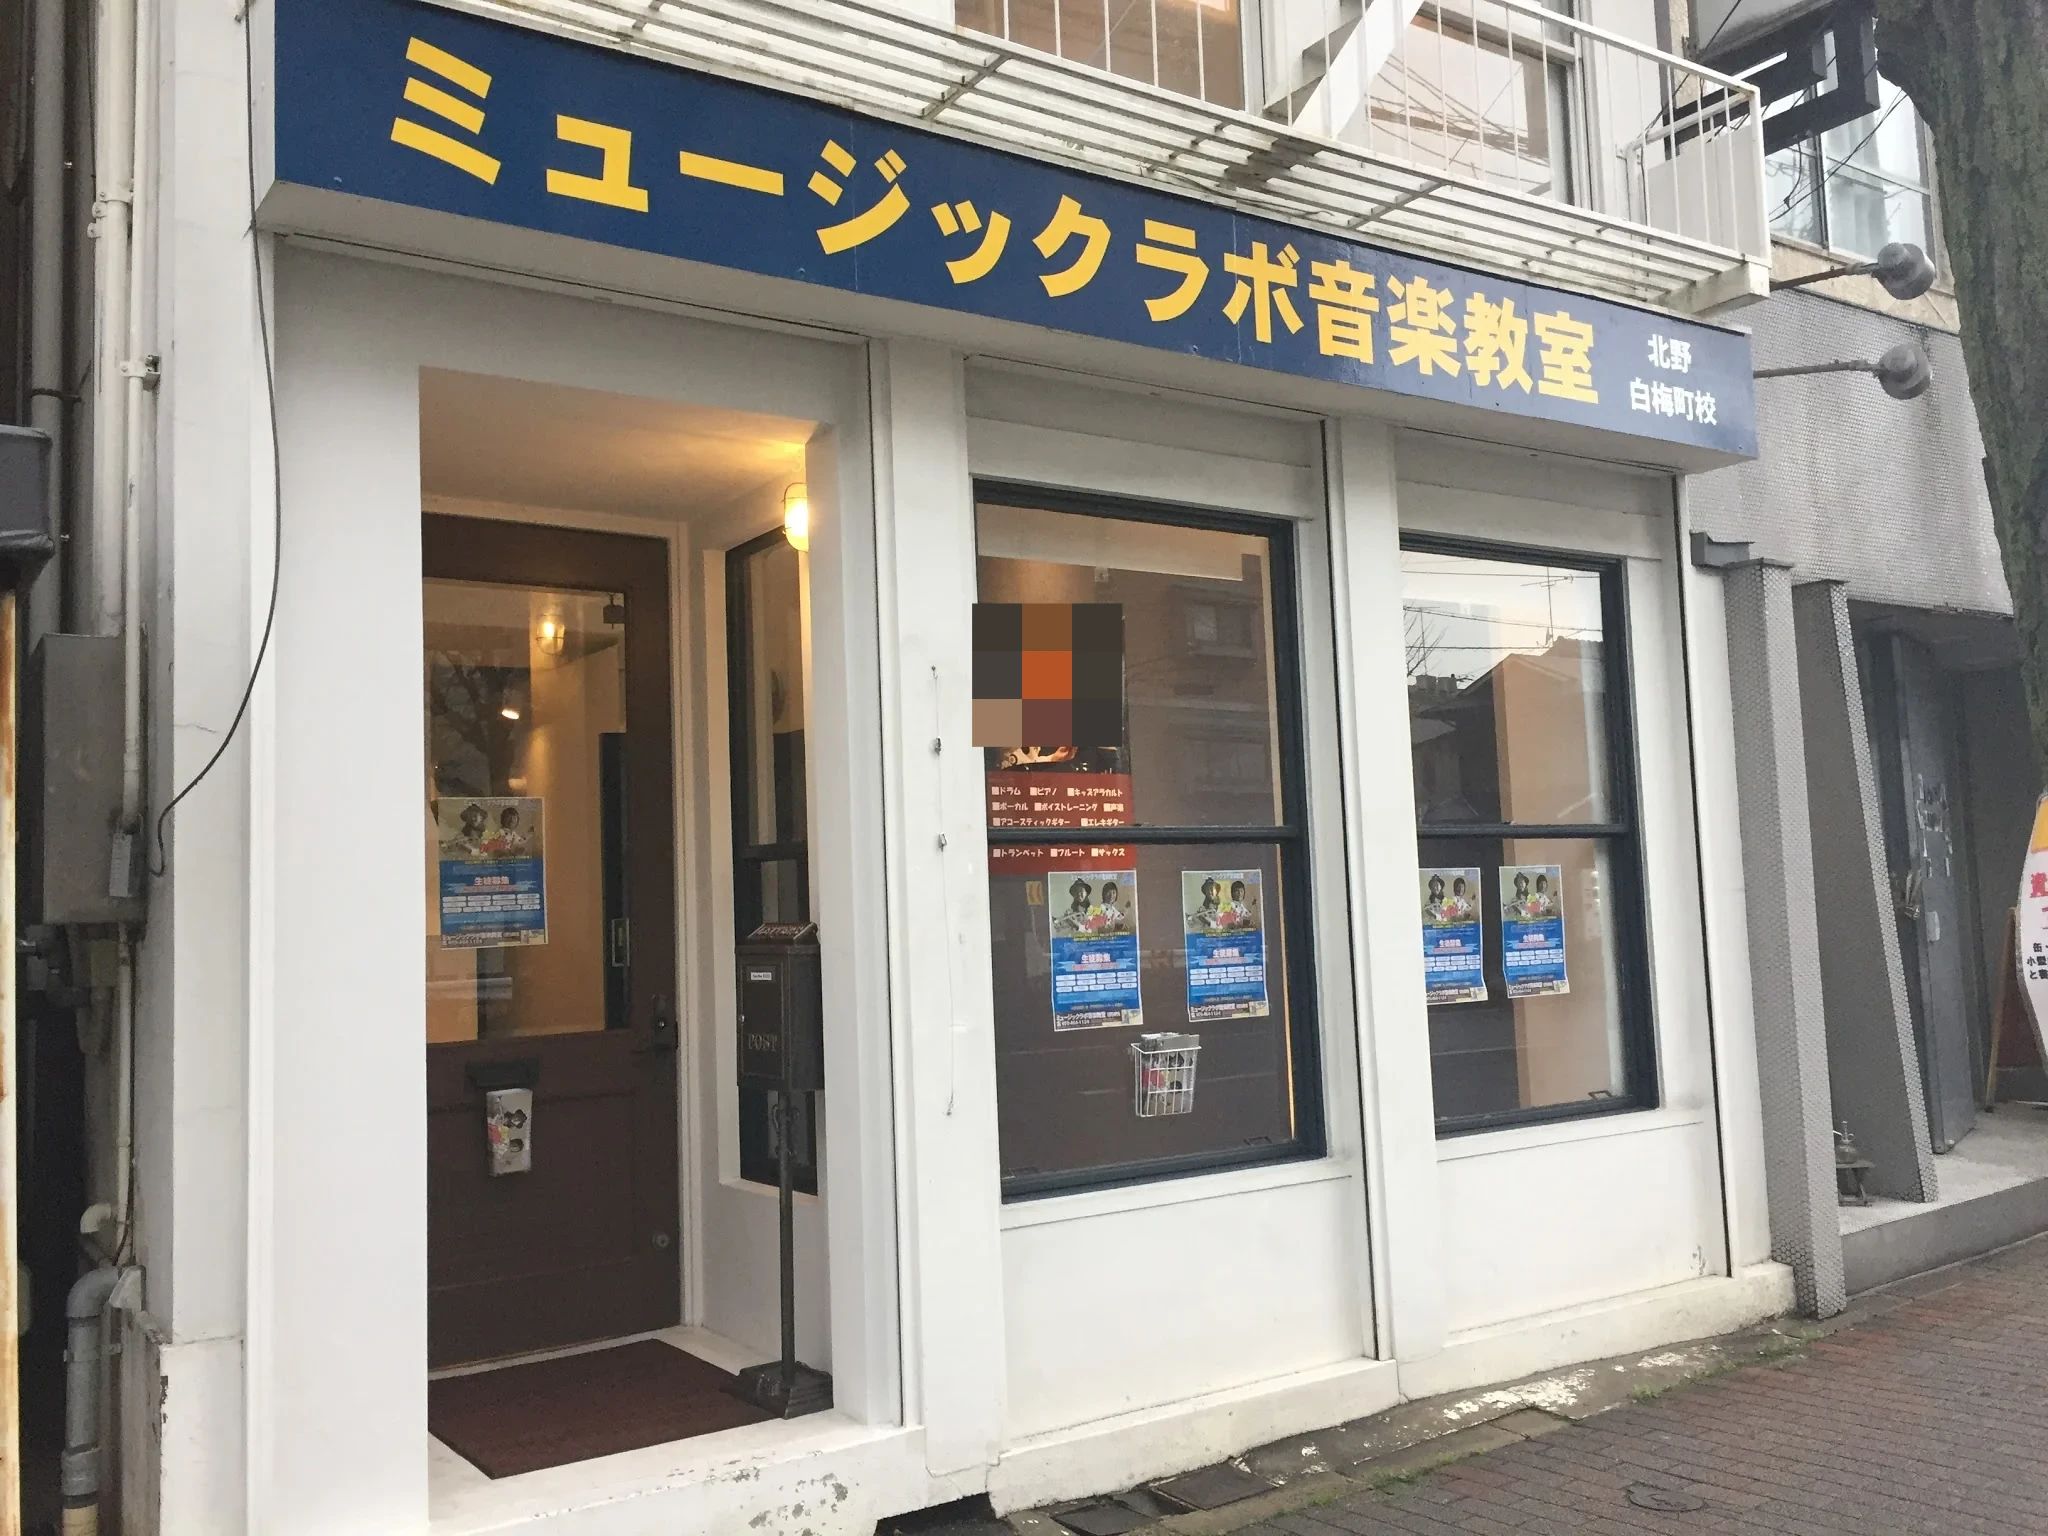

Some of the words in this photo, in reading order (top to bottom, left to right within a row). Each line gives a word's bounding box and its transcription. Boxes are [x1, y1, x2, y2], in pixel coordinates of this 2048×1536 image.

[391, 37, 1599, 405] ミュージックラボ音楽教室
[1647, 333, 1692, 373] 北野
[1630, 377, 1717, 425] 白梅町校
